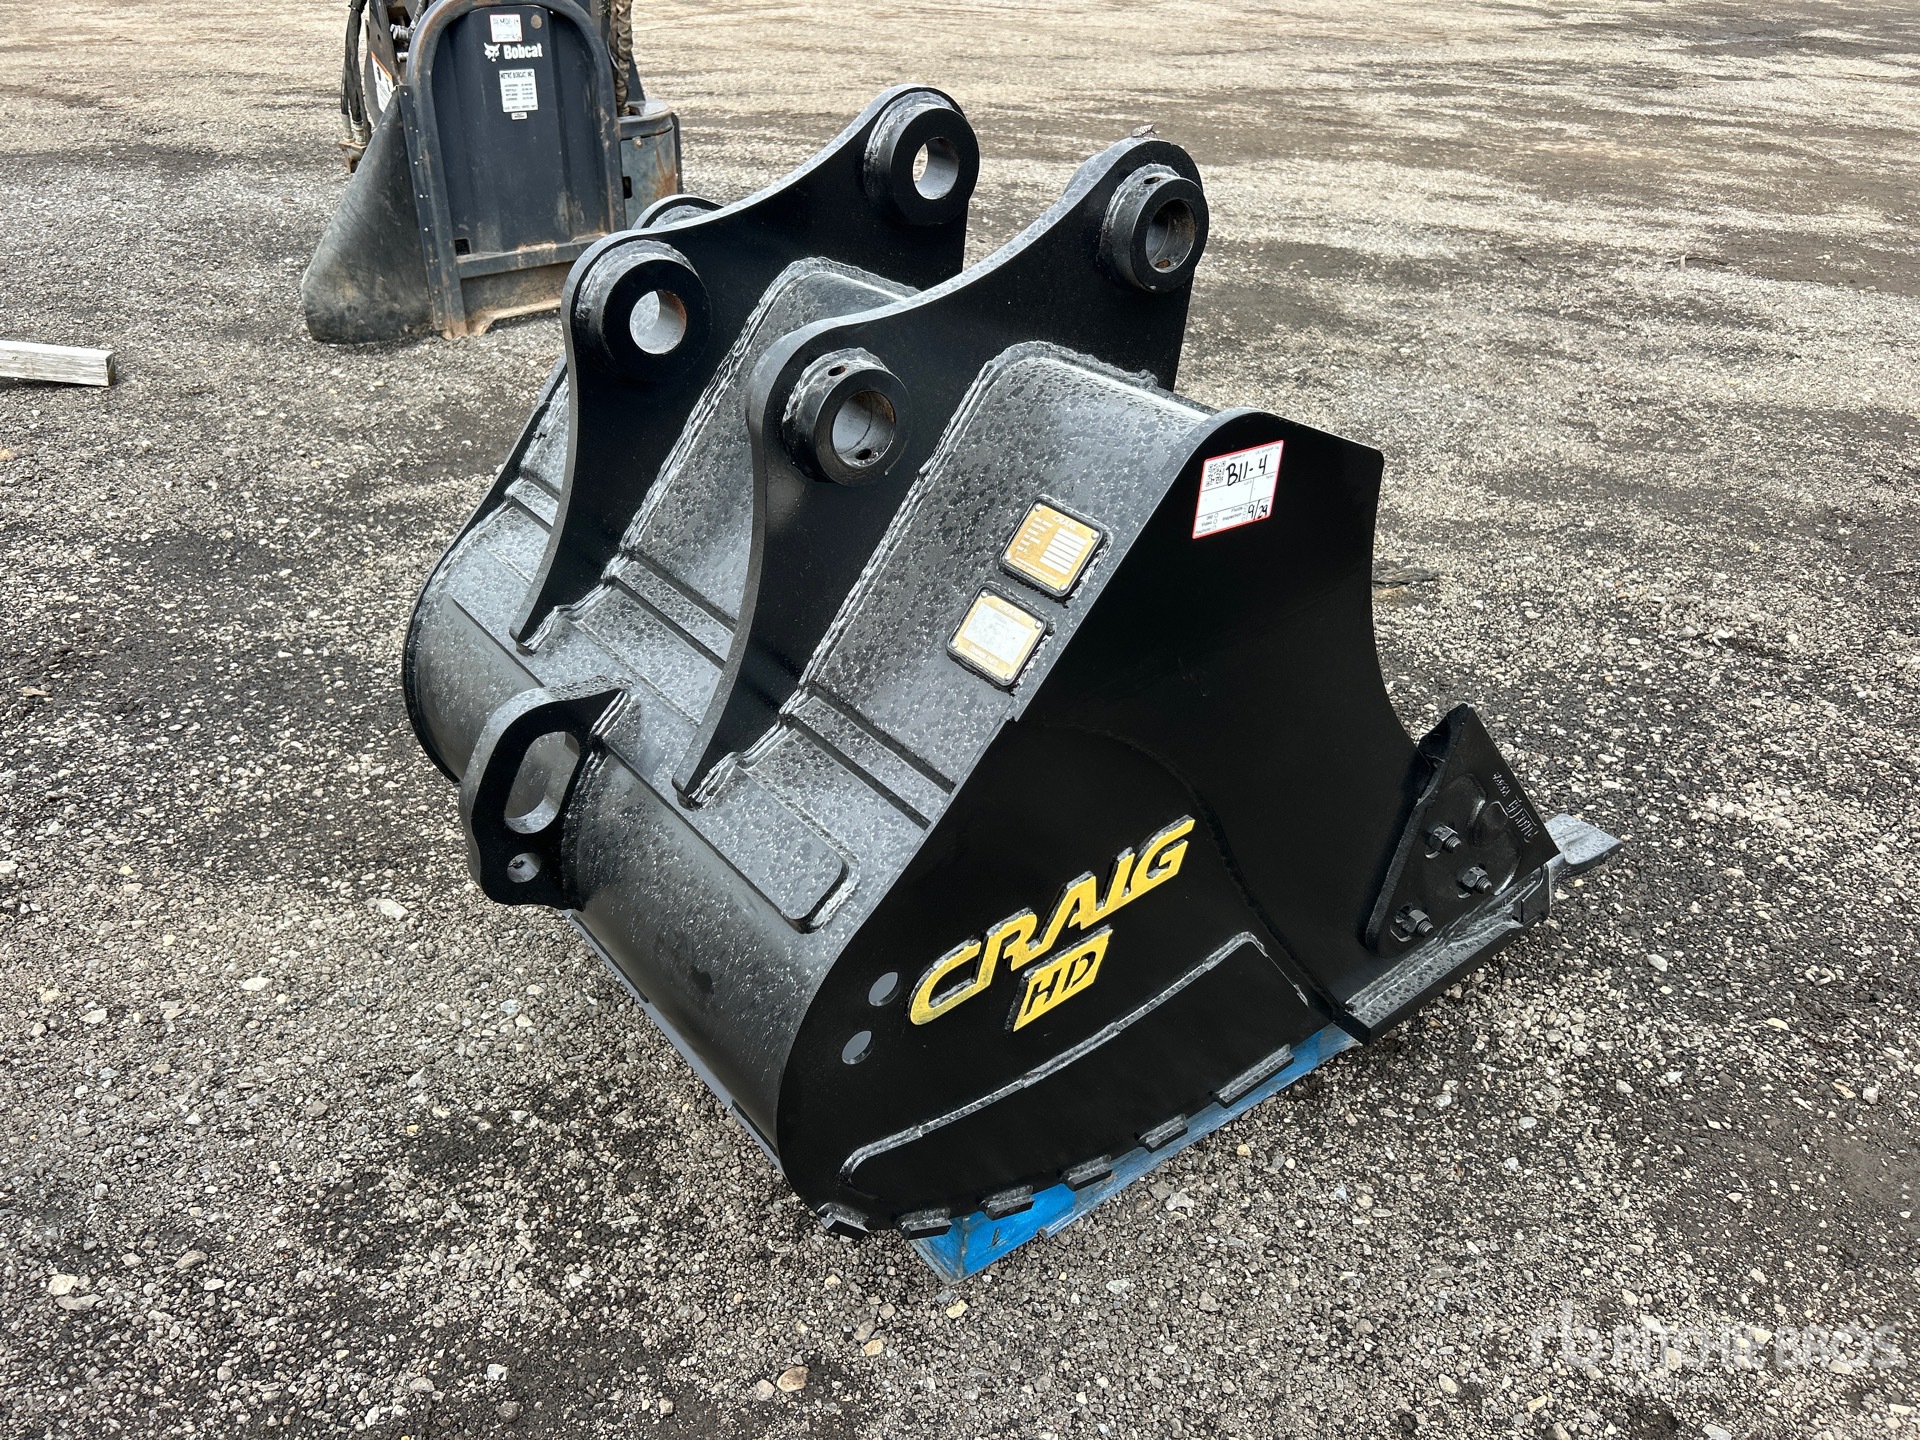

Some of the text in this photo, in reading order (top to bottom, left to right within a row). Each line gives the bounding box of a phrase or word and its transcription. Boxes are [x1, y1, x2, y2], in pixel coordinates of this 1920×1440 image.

[503, 43, 543, 60] Bobcat
[909, 814, 1195, 1026] CRAIG
[1023, 950, 1098, 1017] HD
